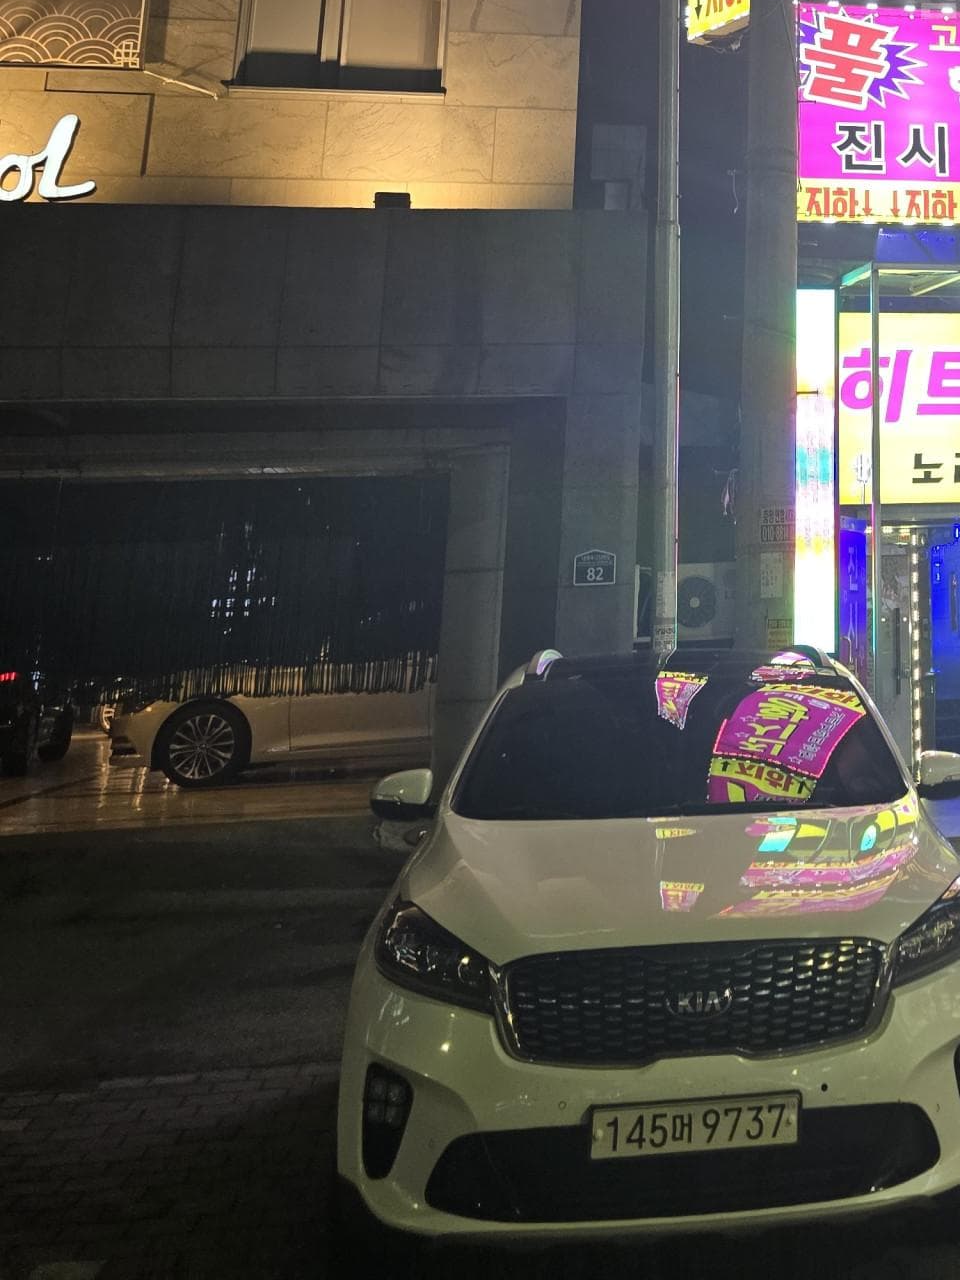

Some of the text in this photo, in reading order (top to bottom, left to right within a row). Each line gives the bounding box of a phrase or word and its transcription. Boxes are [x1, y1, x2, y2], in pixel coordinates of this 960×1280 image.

[799, 12, 892, 110] 풀
[805, 186, 858, 219] 지하
[905, 188, 958, 220] 지하
[586, 567, 604, 581] 82
[678, 991, 721, 1014] KIA
